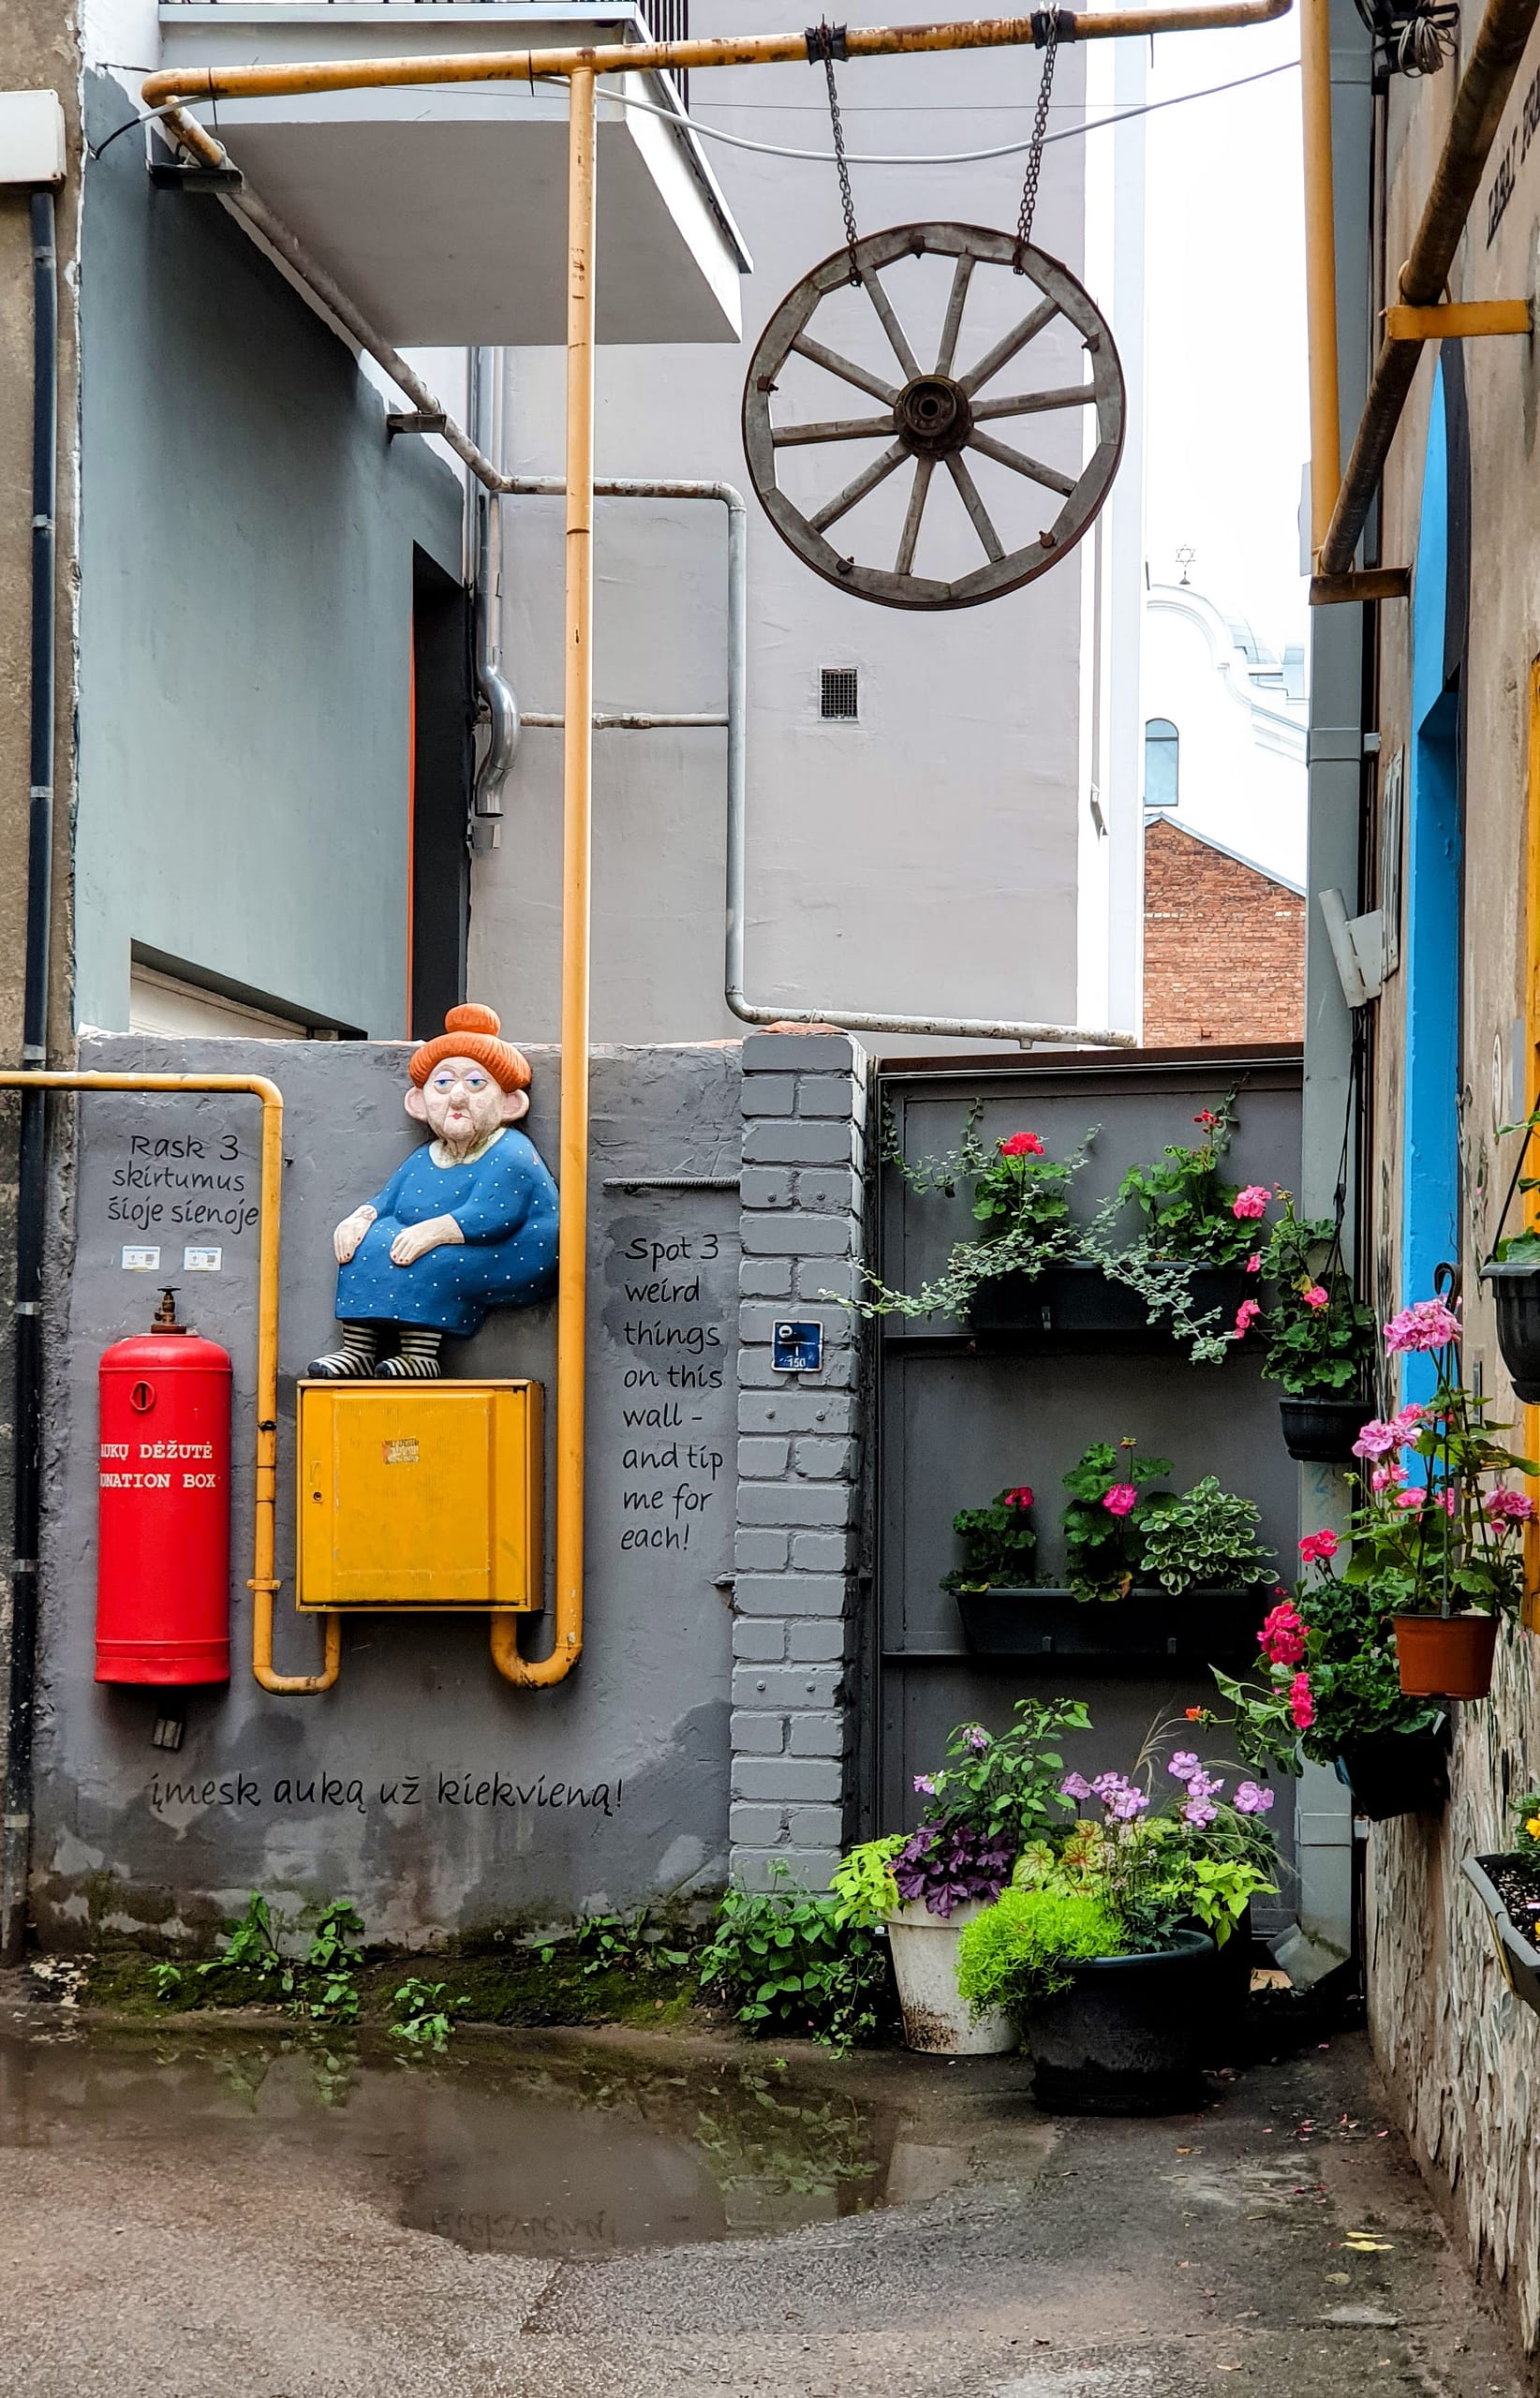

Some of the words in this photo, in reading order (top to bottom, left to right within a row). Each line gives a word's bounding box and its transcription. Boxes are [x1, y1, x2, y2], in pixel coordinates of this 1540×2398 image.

[130, 1134, 206, 1160] Rask
[218, 1134, 239, 1162] 3
[111, 1160, 245, 1192] skirtumus
[107, 1195, 164, 1231] šioje
[170, 1198, 259, 1235] sienoje
[624, 1236, 692, 1273] Spot
[700, 1234, 719, 1260] 3
[624, 1275, 700, 1304] weird
[623, 1320, 721, 1355] things
[623, 1369, 659, 1388] on
[666, 1363, 723, 1389] this
[622, 1401, 683, 1428] wall
[140, 1440, 213, 1458] DĖŽUTĖ
[622, 1441, 679, 1470] and
[686, 1443, 724, 1482] tip
[182, 1473, 216, 1488] BOX
[623, 1489, 664, 1510] me
[672, 1482, 713, 1520] for
[620, 1523, 689, 1551] each!
[151, 1772, 262, 1813] įmesk
[274, 1770, 367, 1814] auką
[379, 1775, 422, 1806] už
[437, 1771, 623, 1817] kiekvieną!
